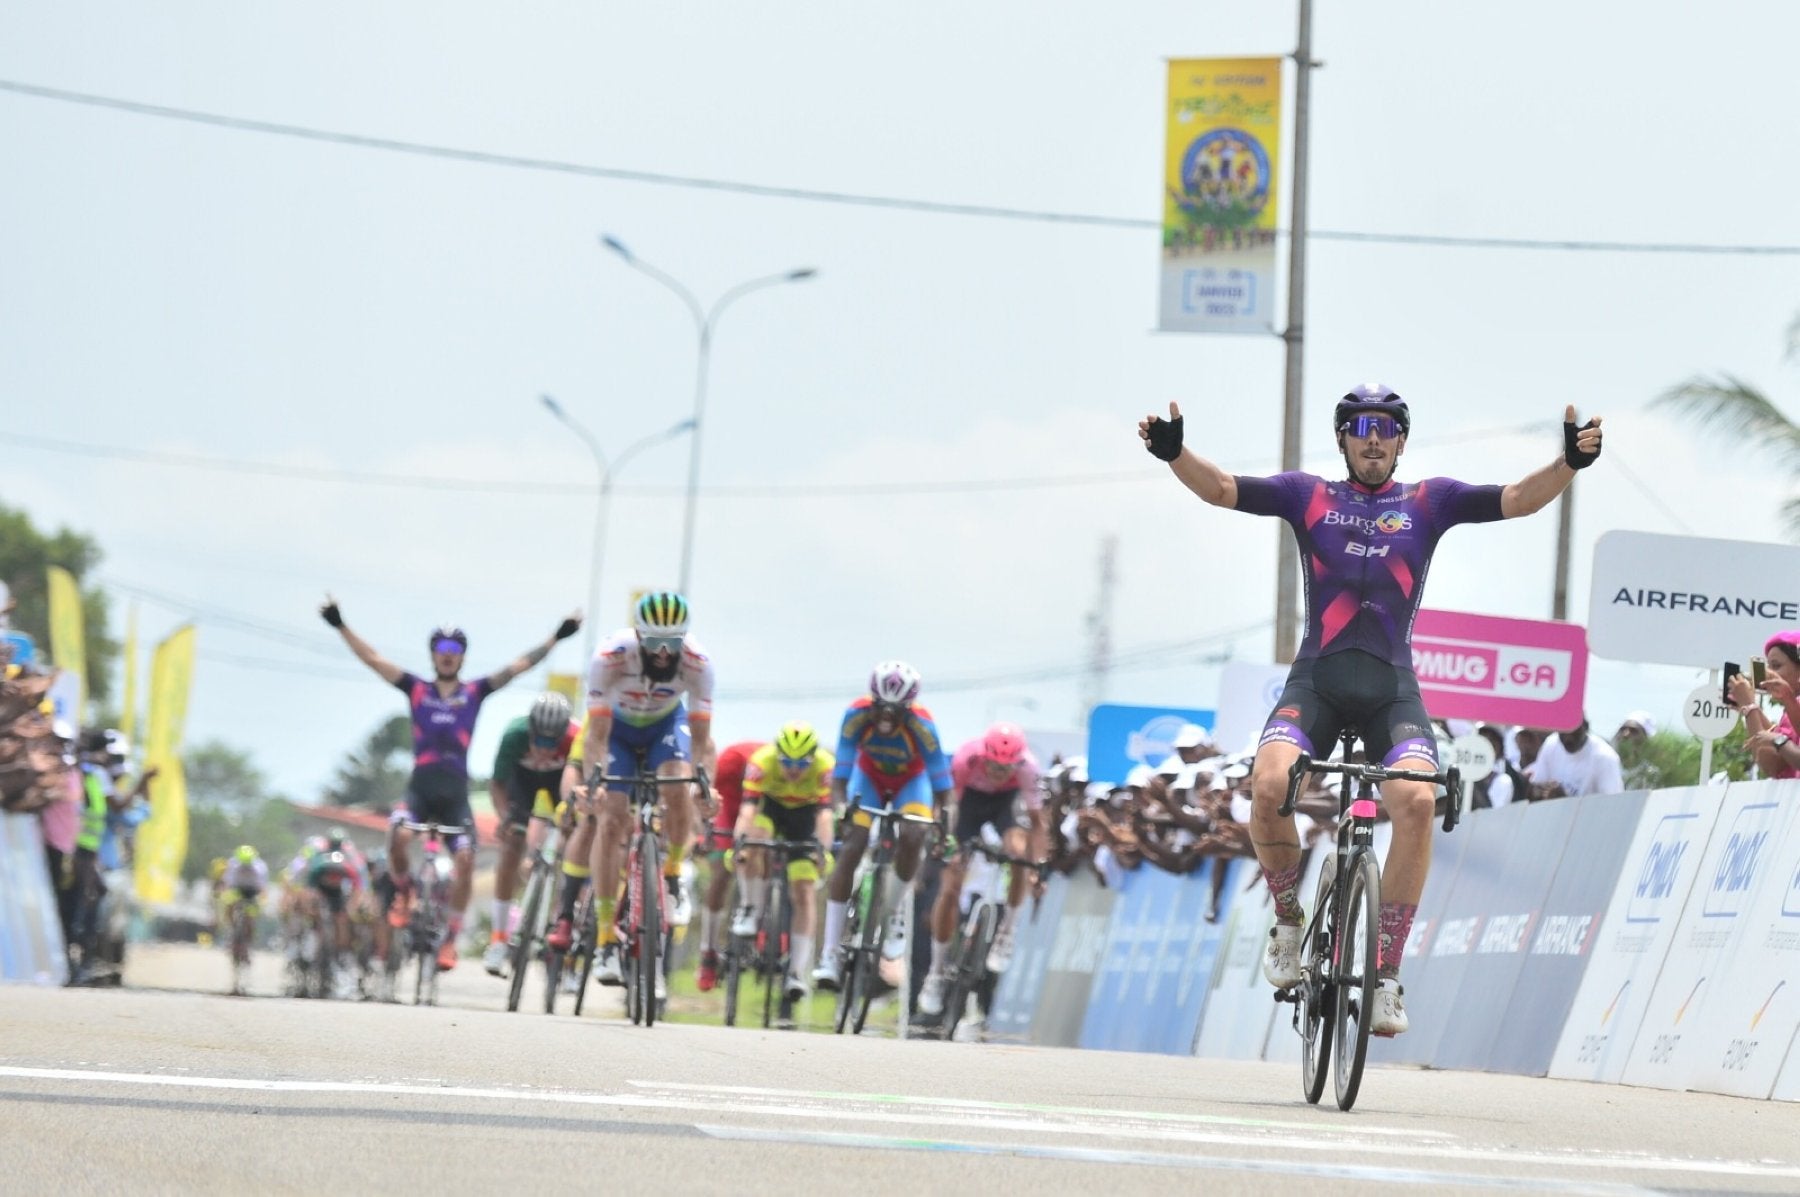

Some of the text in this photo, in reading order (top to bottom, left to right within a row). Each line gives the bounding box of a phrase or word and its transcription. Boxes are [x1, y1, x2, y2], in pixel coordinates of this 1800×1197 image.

[1344, 541, 1390, 558] BH
[1612, 587, 1799, 621] AIRFRANCE
[1692, 700, 1730, 719] 20 m
